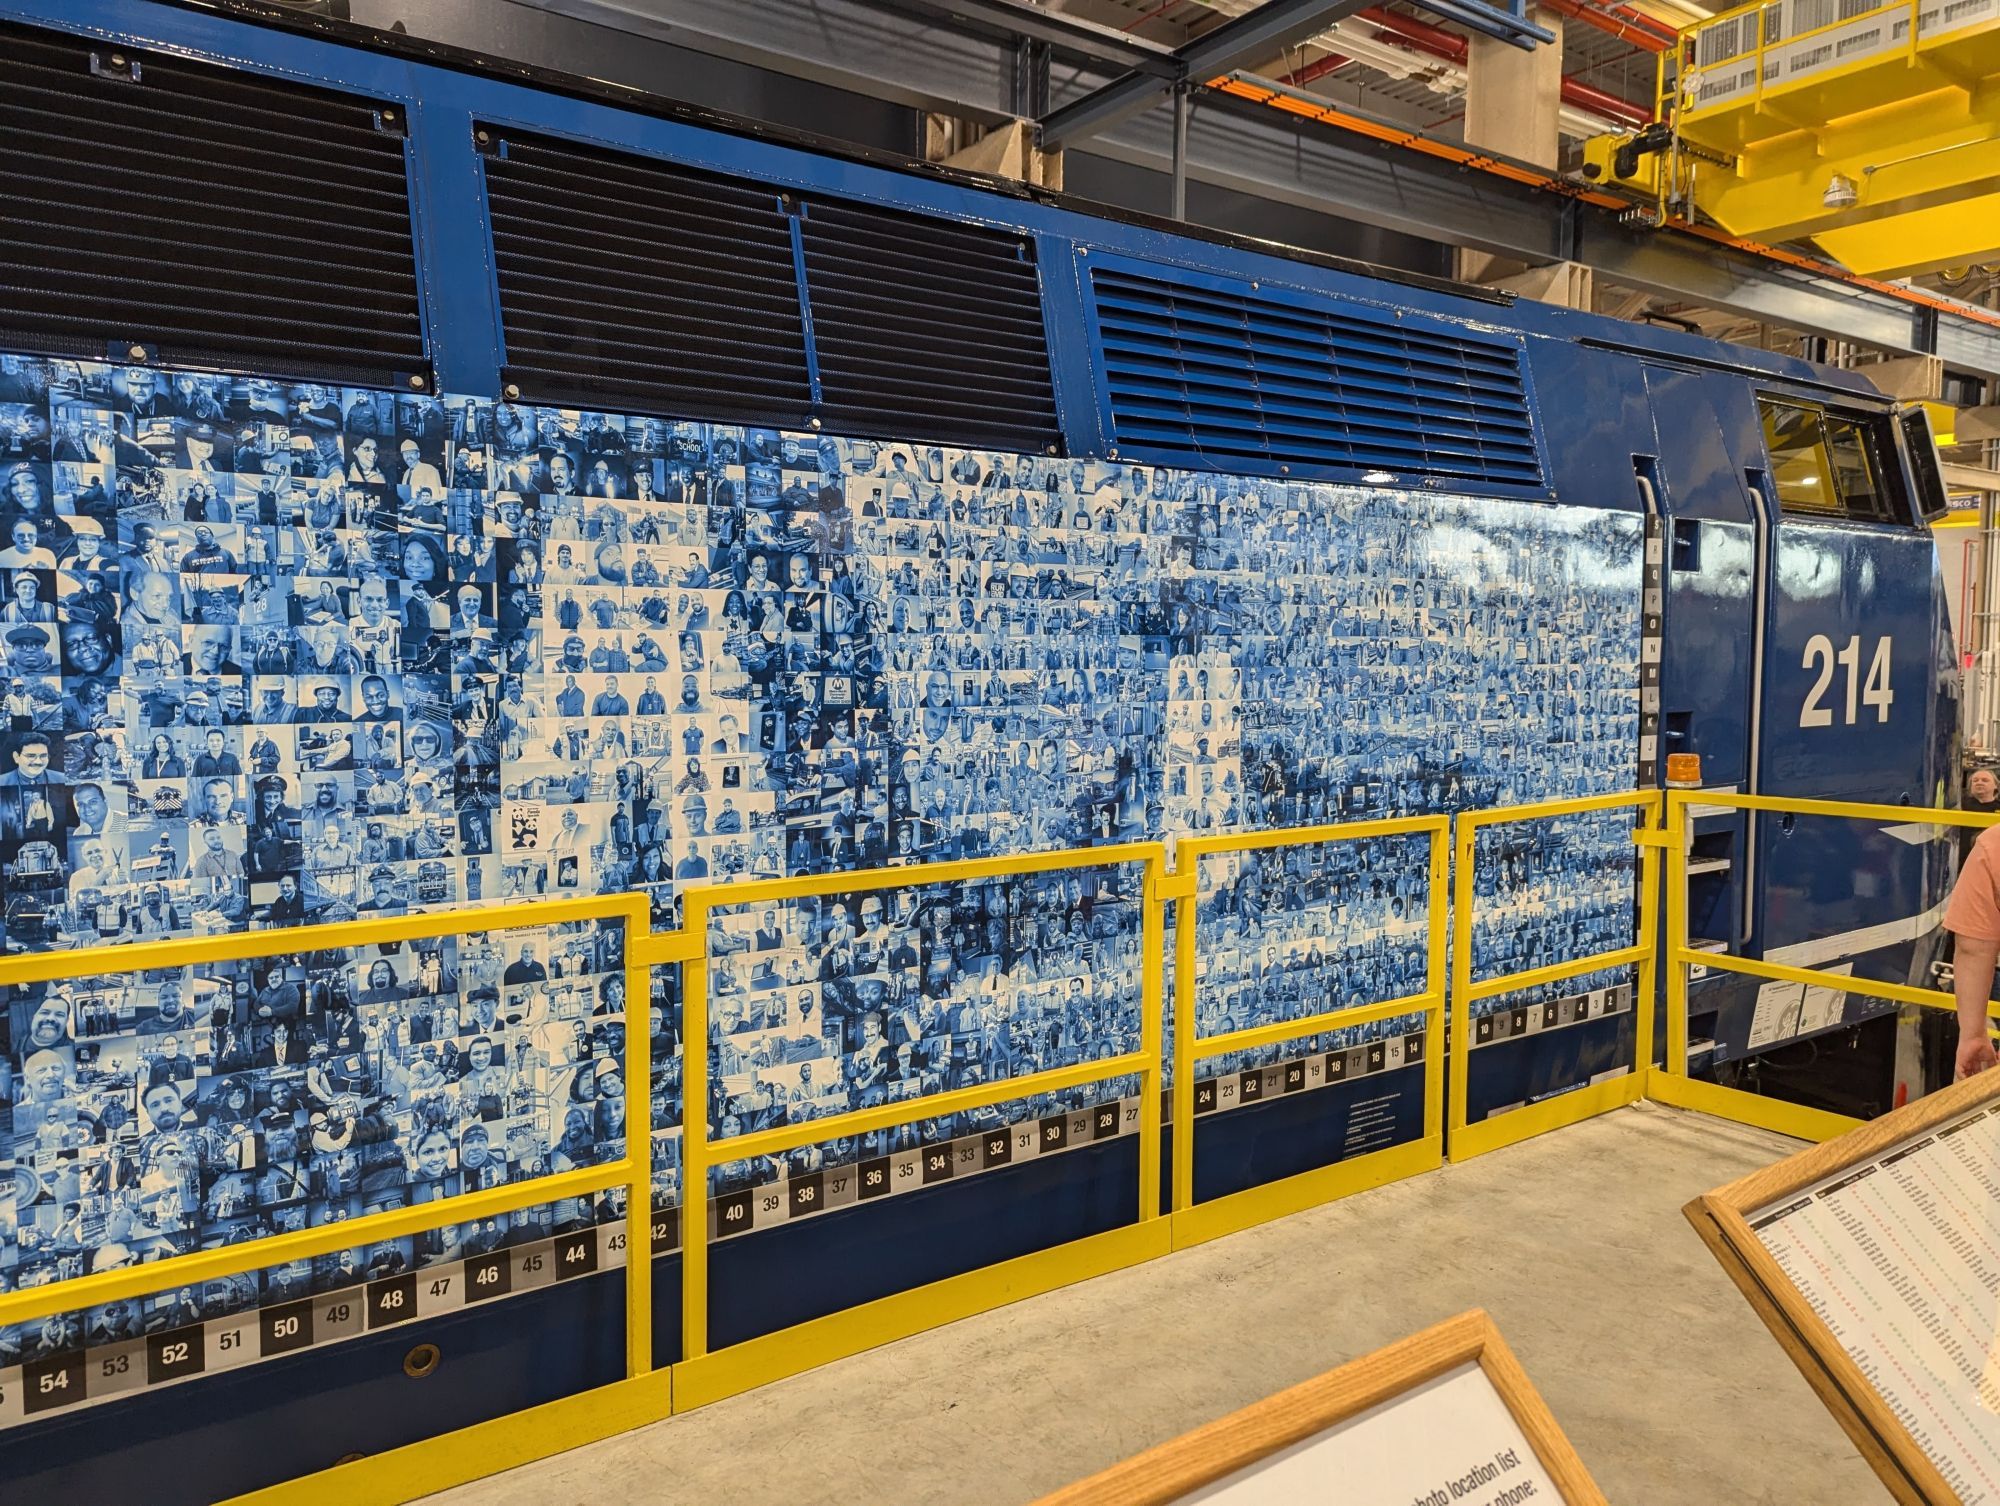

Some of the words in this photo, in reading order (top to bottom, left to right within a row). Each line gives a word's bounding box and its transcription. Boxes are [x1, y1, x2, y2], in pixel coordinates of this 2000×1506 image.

[680, 442, 703, 453] SCHOOL
[1654, 520, 1659, 530] S
[991, 582, 1004, 591] RUN
[1652, 595, 1657, 604] P
[253, 598, 267, 614] 128
[1650, 644, 1656, 653] N
[1649, 668, 1656, 678] M
[1800, 634, 1894, 728] 214
[1647, 717, 1653, 727] K
[1311, 868, 1322, 878] 126
[40, 1370, 68, 1393] 54
[103, 1355, 129, 1376] 53
[162, 1342, 188, 1364] 52
[220, 1330, 241, 1350] 51
[274, 1317, 298, 1338] 50
[326, 1305, 350, 1323] 49
[380, 1290, 403, 1309] 48
[430, 1279, 450, 1296] 47
[477, 1266, 498, 1285] 46
[523, 1255, 542, 1272] 45
[566, 1244, 586, 1262] 44
[608, 1234, 626, 1251] 43
[651, 1223, 666, 1240] 42
[726, 1204, 743, 1221] 40
[763, 1196, 779, 1212] 39
[798, 1187, 814, 1202] 38
[832, 1178, 847, 1193] 37
[867, 1170, 882, 1186] 36
[899, 1163, 913, 1177] 35
[930, 1155, 945, 1170] 34
[961, 1148, 975, 1162] 33
[990, 1140, 1004, 1155] 32
[1019, 1134, 1031, 1148] 31
[1046, 1126, 1060, 1140] 30
[1074, 1120, 1086, 1133] 29
[1100, 1113, 1112, 1128] 28
[1126, 1108, 1138, 1121] 27
[1200, 1090, 1210, 1103] 24
[1223, 1085, 1234, 1097] 23
[1246, 1080, 1256, 1092] 22
[1268, 1075, 1277, 1087] 21
[1290, 1070, 1299, 1083] 20
[1311, 1065, 1319, 1076] 19
[1332, 1061, 1340, 1072] 18
[1352, 1056, 1361, 1067] 17
[1372, 1051, 1380, 1062] 16
[1391, 1048, 1399, 1058] 15
[1410, 1042, 1418, 1053] 14
[1481, 1023, 1488, 1035] 10
[1516, 1017, 1521, 1027] 8
[1533, 1014, 1537, 1023] 7
[1548, 1009, 1553, 1019] 6
[1579, 1002, 1583, 1012] 4
[1594, 999, 1598, 1009] 3
[1608, 996, 1612, 1006] 2
[1445, 1465, 1500, 1500] location
[1494, 1448, 1522, 1472] list
